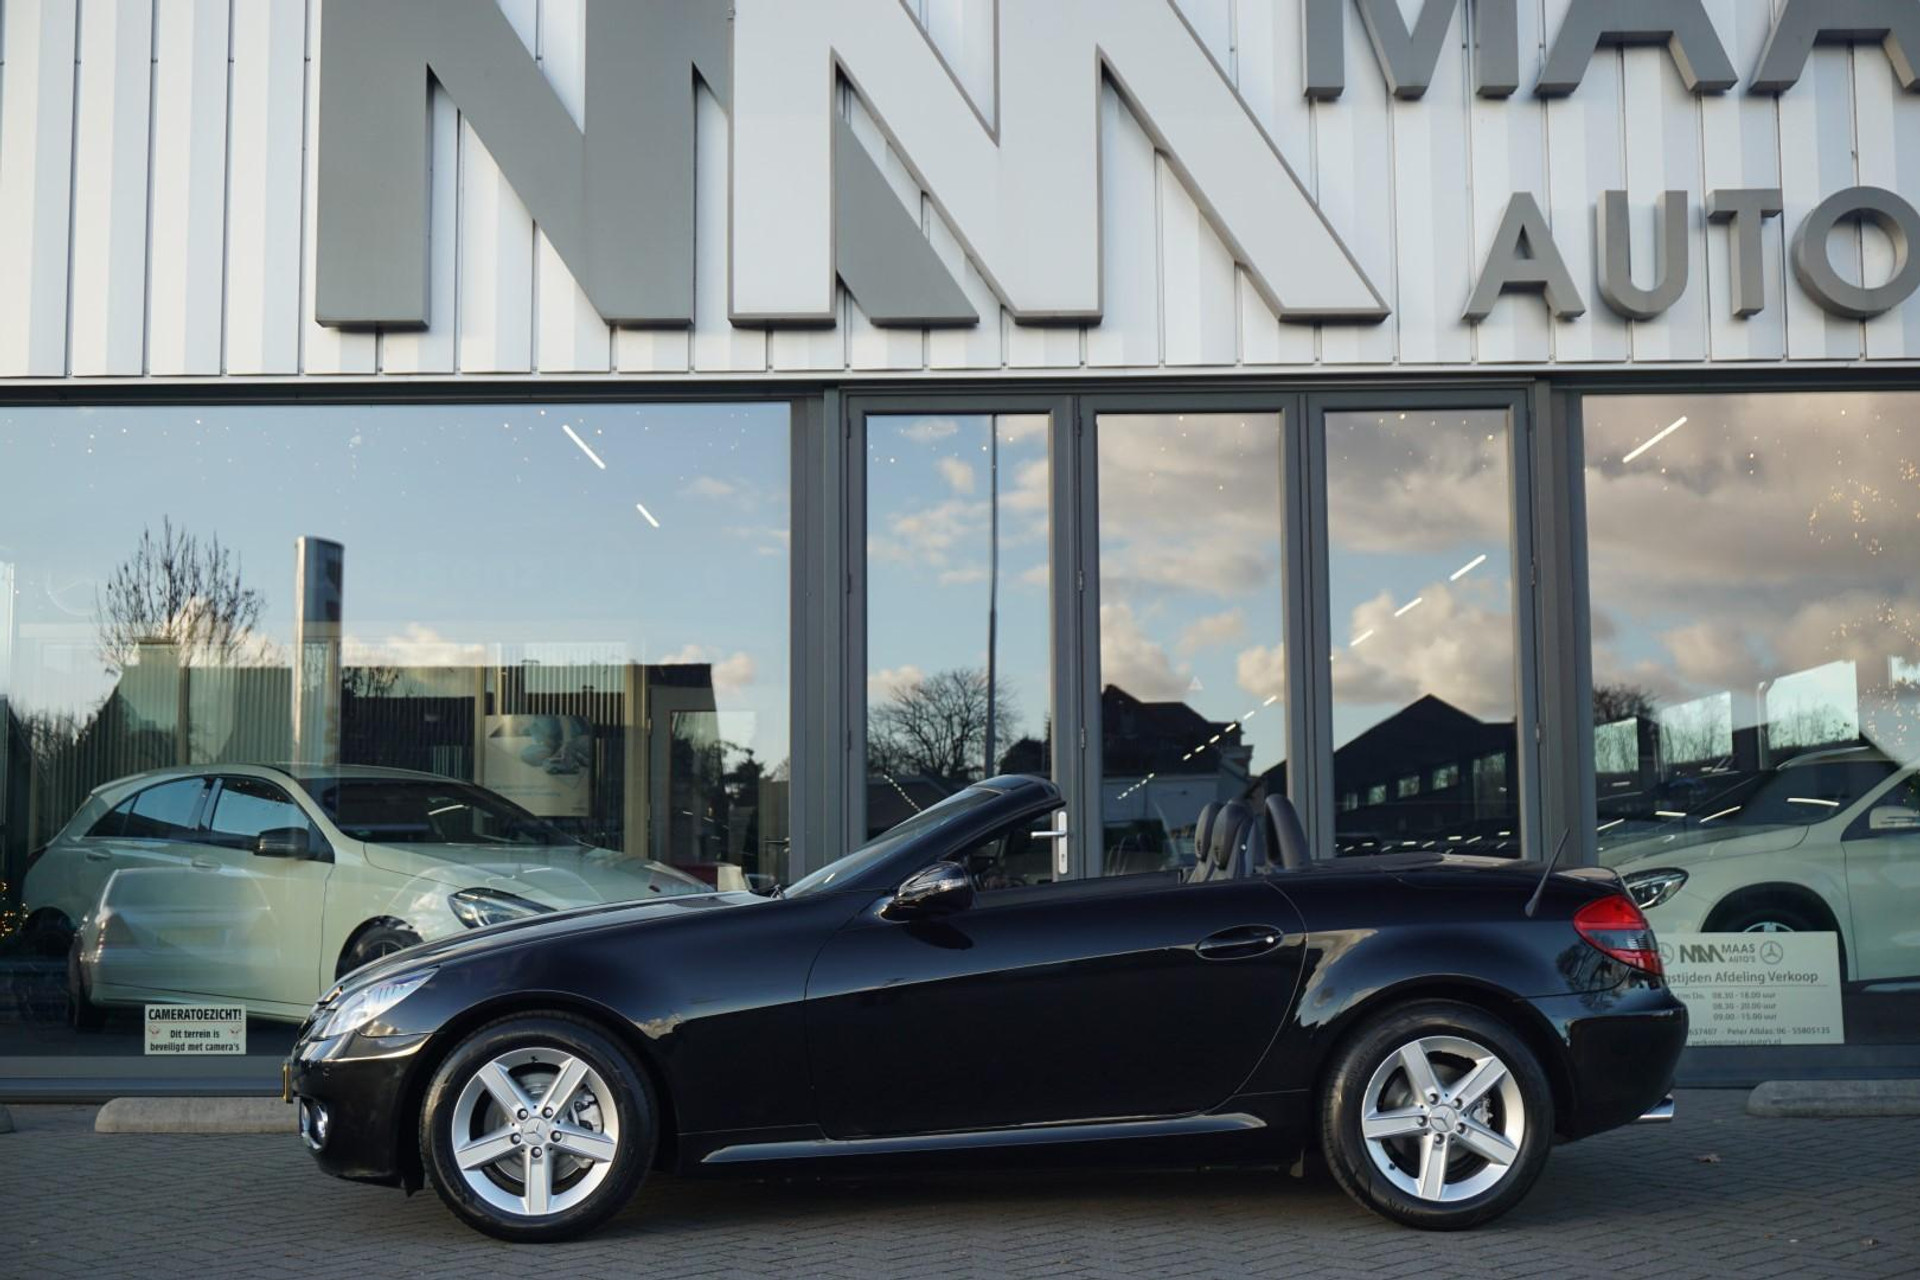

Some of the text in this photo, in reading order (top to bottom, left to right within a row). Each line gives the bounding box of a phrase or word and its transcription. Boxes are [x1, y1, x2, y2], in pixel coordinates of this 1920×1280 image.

[1461, 185, 1920, 322] AUTO
[1721, 943, 1755, 953] MAAS
[1728, 955, 1756, 963] AUTO'S
[1715, 971, 1765, 984] Afdeling
[1767, 971, 1819, 983] Verkoop
[148, 1008, 242, 1020] CAMERATOEZICHT!
[170, 1029, 220, 1038] Dit terrein is
[150, 1042, 240, 1052] beveiligd met camera's
